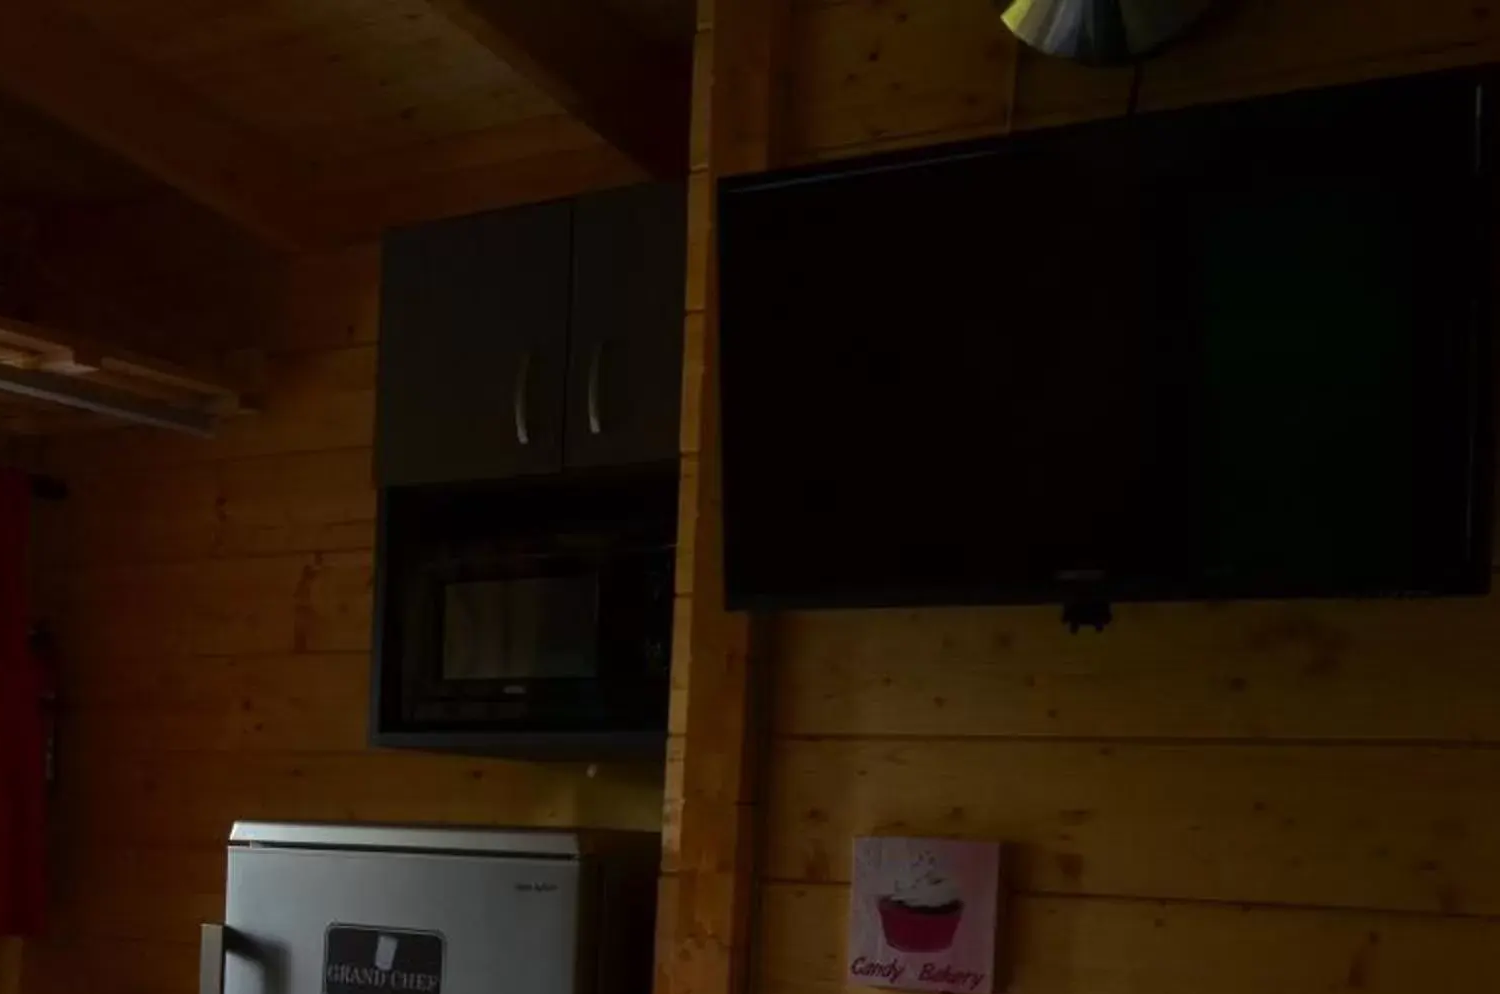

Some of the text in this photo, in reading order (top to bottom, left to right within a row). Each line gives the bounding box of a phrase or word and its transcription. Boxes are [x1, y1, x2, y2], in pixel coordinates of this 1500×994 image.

[327, 963, 438, 993] GRAND CHEF
[851, 956, 985, 991] Candy Bakery
